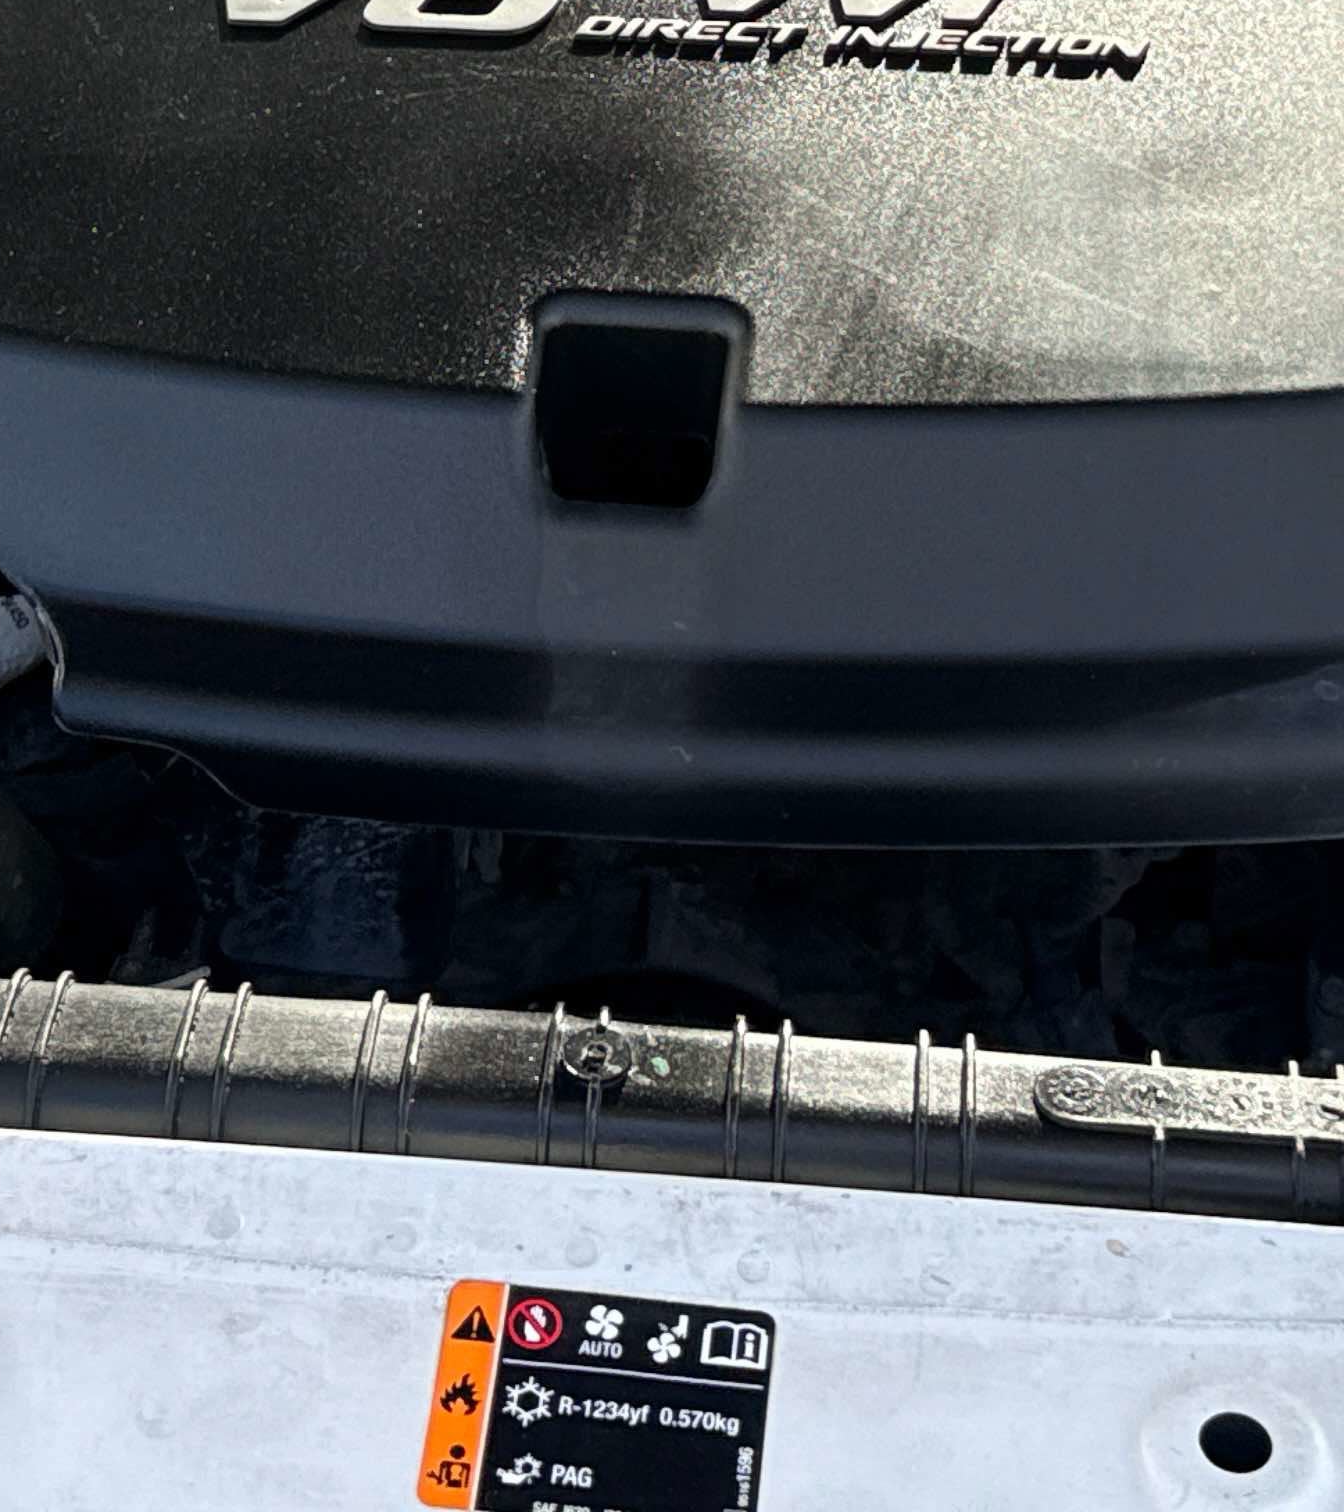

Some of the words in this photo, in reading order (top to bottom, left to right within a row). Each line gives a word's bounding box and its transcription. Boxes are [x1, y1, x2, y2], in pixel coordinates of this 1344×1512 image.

[573, 15, 806, 52] DIRECT
[825, 26, 1150, 74] INJECTION
[578, 1340, 623, 1359] AUTO
[558, 1396, 650, 1424] R-1234yf
[659, 1407, 740, 1436] 0.570kg
[550, 1464, 594, 1488] PAG
